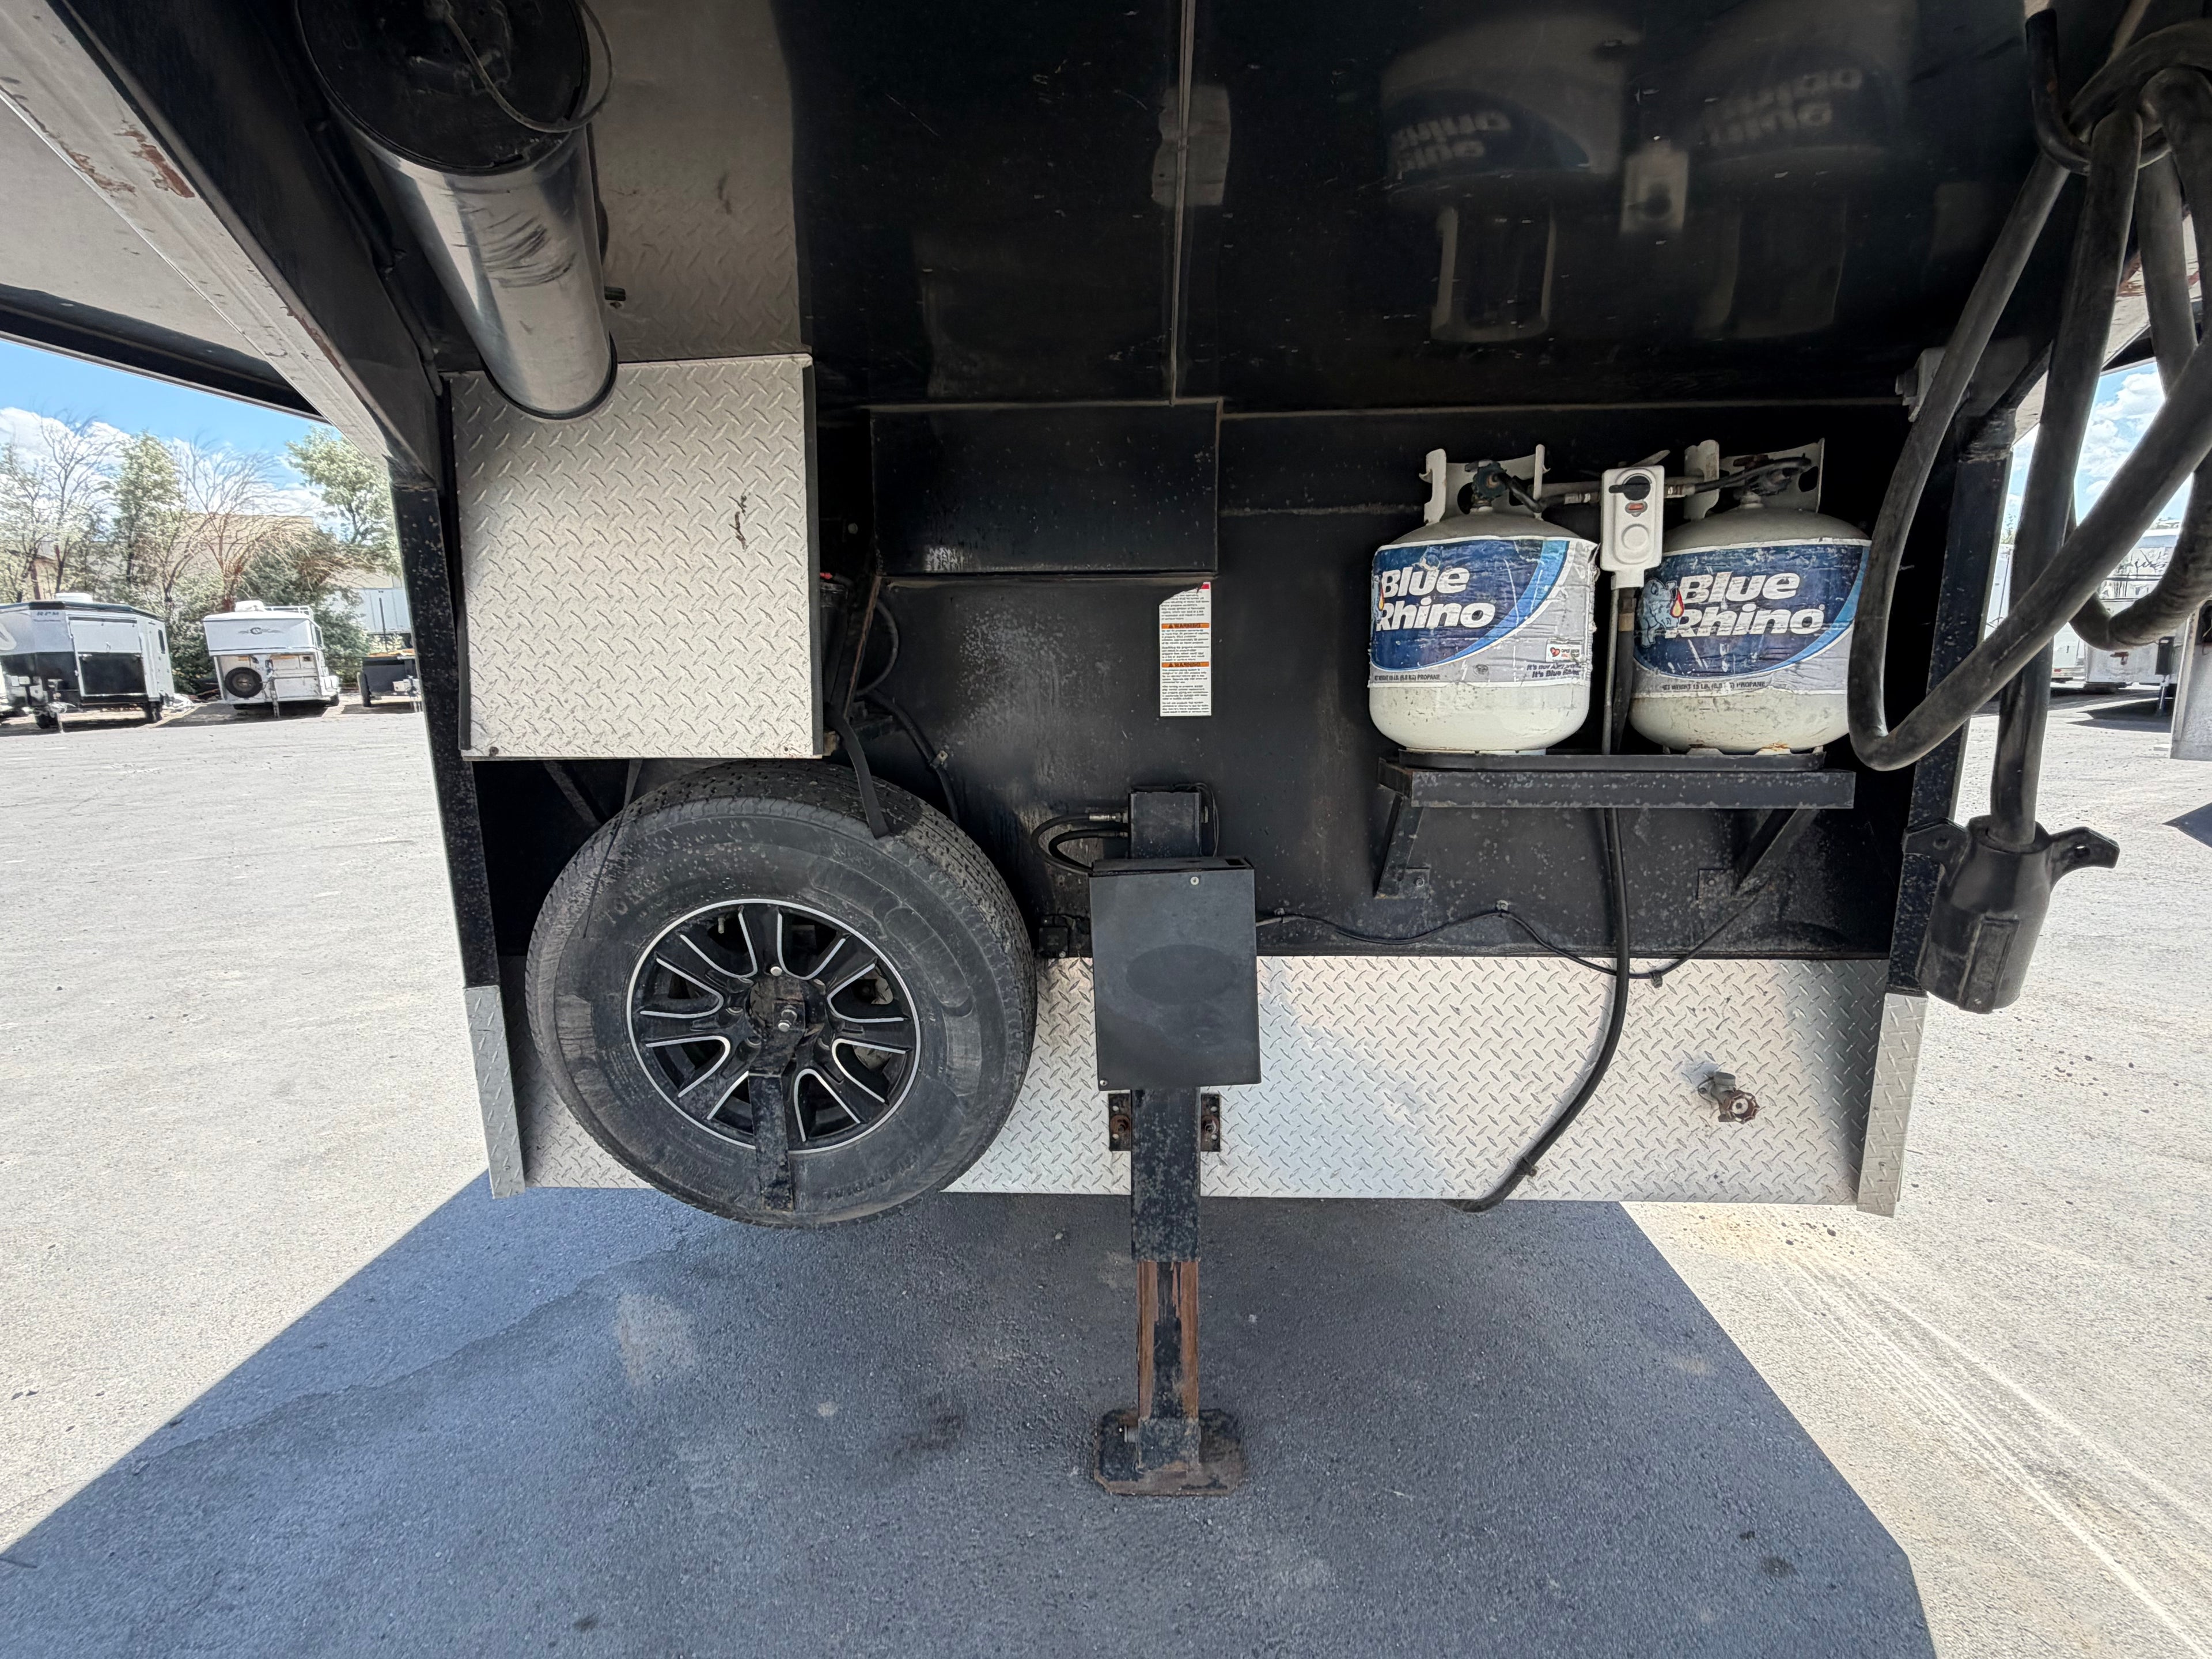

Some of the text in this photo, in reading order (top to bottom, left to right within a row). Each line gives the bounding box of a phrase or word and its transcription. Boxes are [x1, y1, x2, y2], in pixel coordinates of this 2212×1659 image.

[1381, 566, 1469, 598] Blue
[1679, 571, 1800, 604] Blue
[1376, 597, 1495, 631] Rhino
[1665, 604, 1824, 638] Rhino
